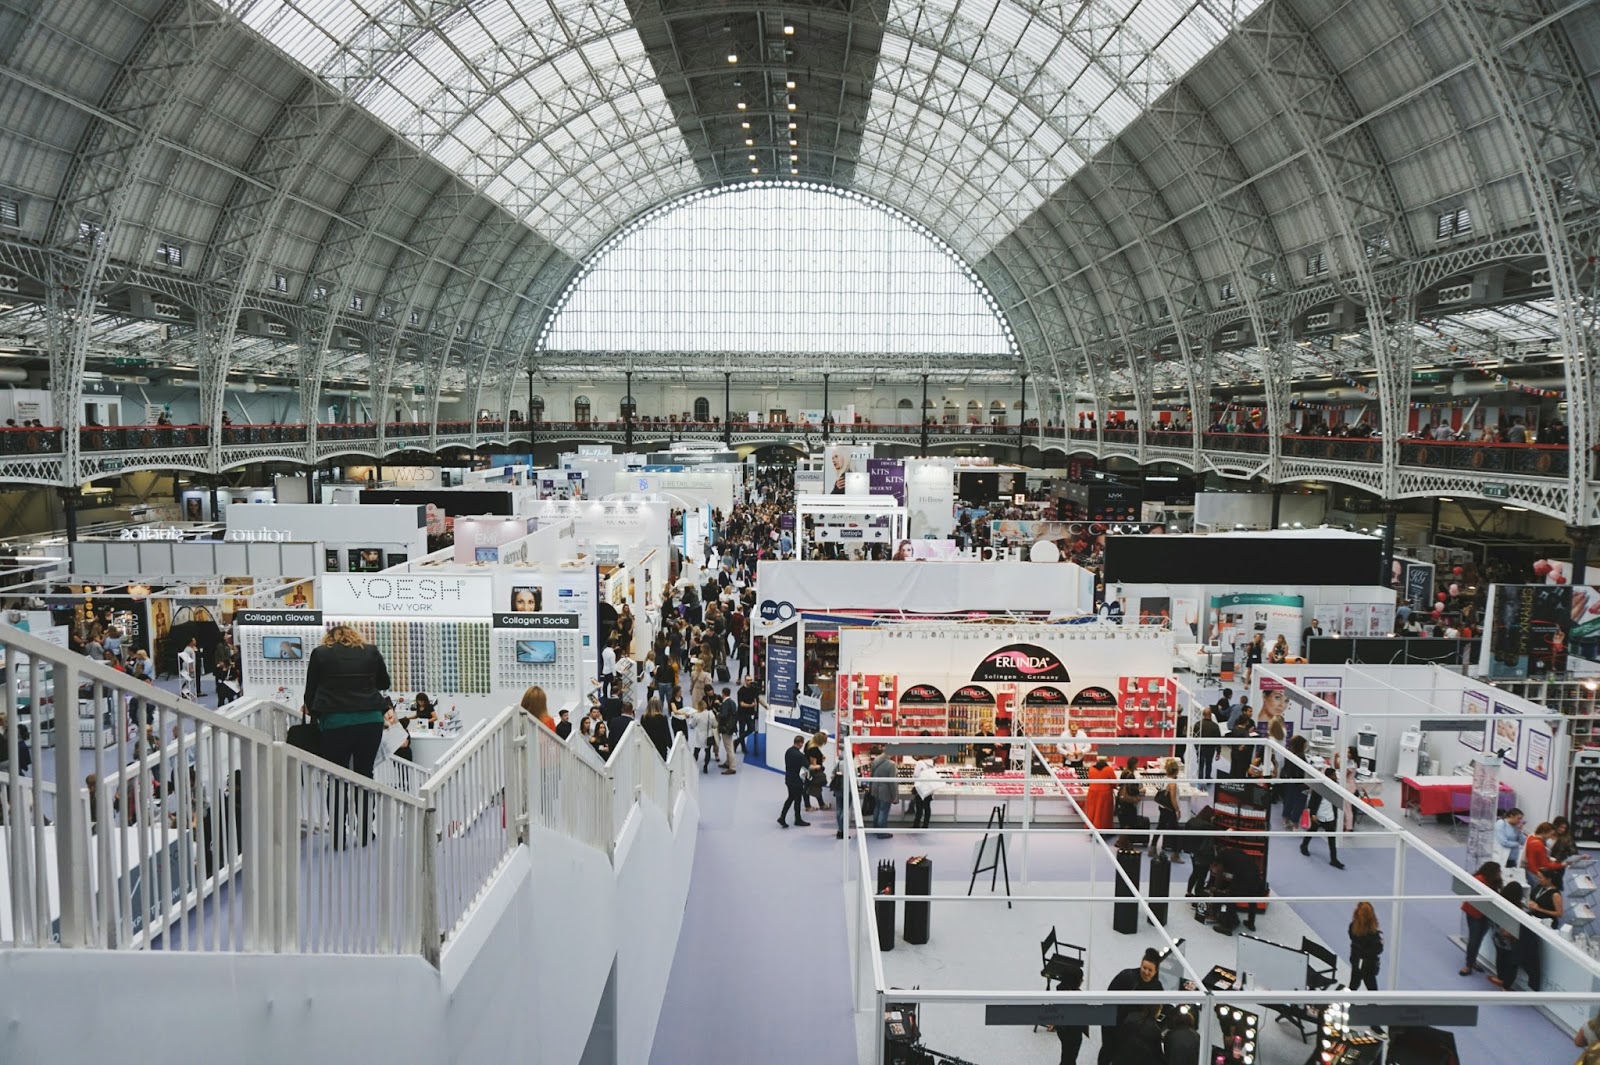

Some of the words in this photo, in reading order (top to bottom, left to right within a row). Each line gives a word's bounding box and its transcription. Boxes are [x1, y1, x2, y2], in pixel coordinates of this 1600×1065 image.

[885, 475, 904, 483] KITS
[346, 578, 461, 600] VOESH
[378, 602, 405, 611] NEW
[406, 602, 433, 612] YORK
[244, 613, 283, 623] Collagen
[285, 613, 315, 622] Gloves
[502, 616, 541, 626] Collagen
[542, 616, 570, 625] Socks
[995, 656, 1048, 668] ERLINDA
[1027, 673, 1059, 681] Germany
